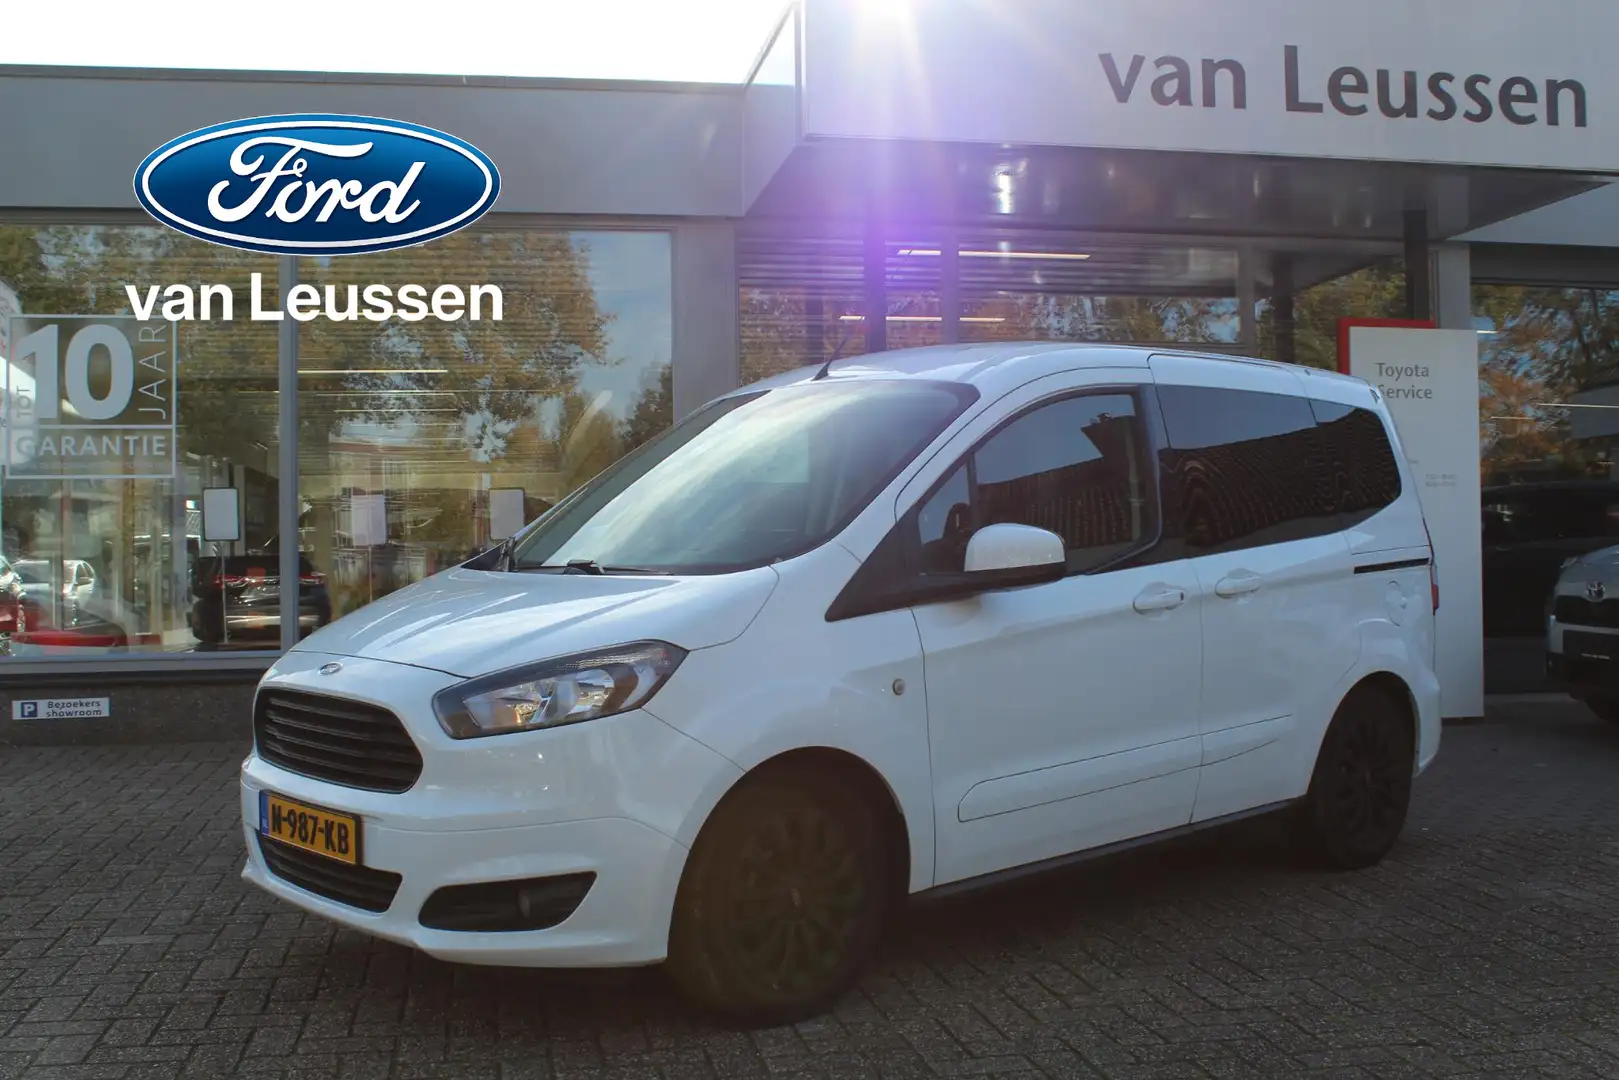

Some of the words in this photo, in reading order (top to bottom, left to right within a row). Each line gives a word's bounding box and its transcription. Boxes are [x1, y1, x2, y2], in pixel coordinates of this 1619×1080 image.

[1098, 52, 1247, 109] van
[1284, 45, 1588, 128] Leussen
[15, 324, 134, 420] 10
[138, 325, 167, 420] JAAR
[1374, 362, 1430, 381] Toyota
[16, 385, 32, 419] TOT
[15, 435, 166, 456] GARANTIE
[23, 703, 36, 716] P
[46, 709, 102, 718] showroom
[47, 700, 101, 710] Bezoekers
[271, 803, 350, 855] N-987-KB
